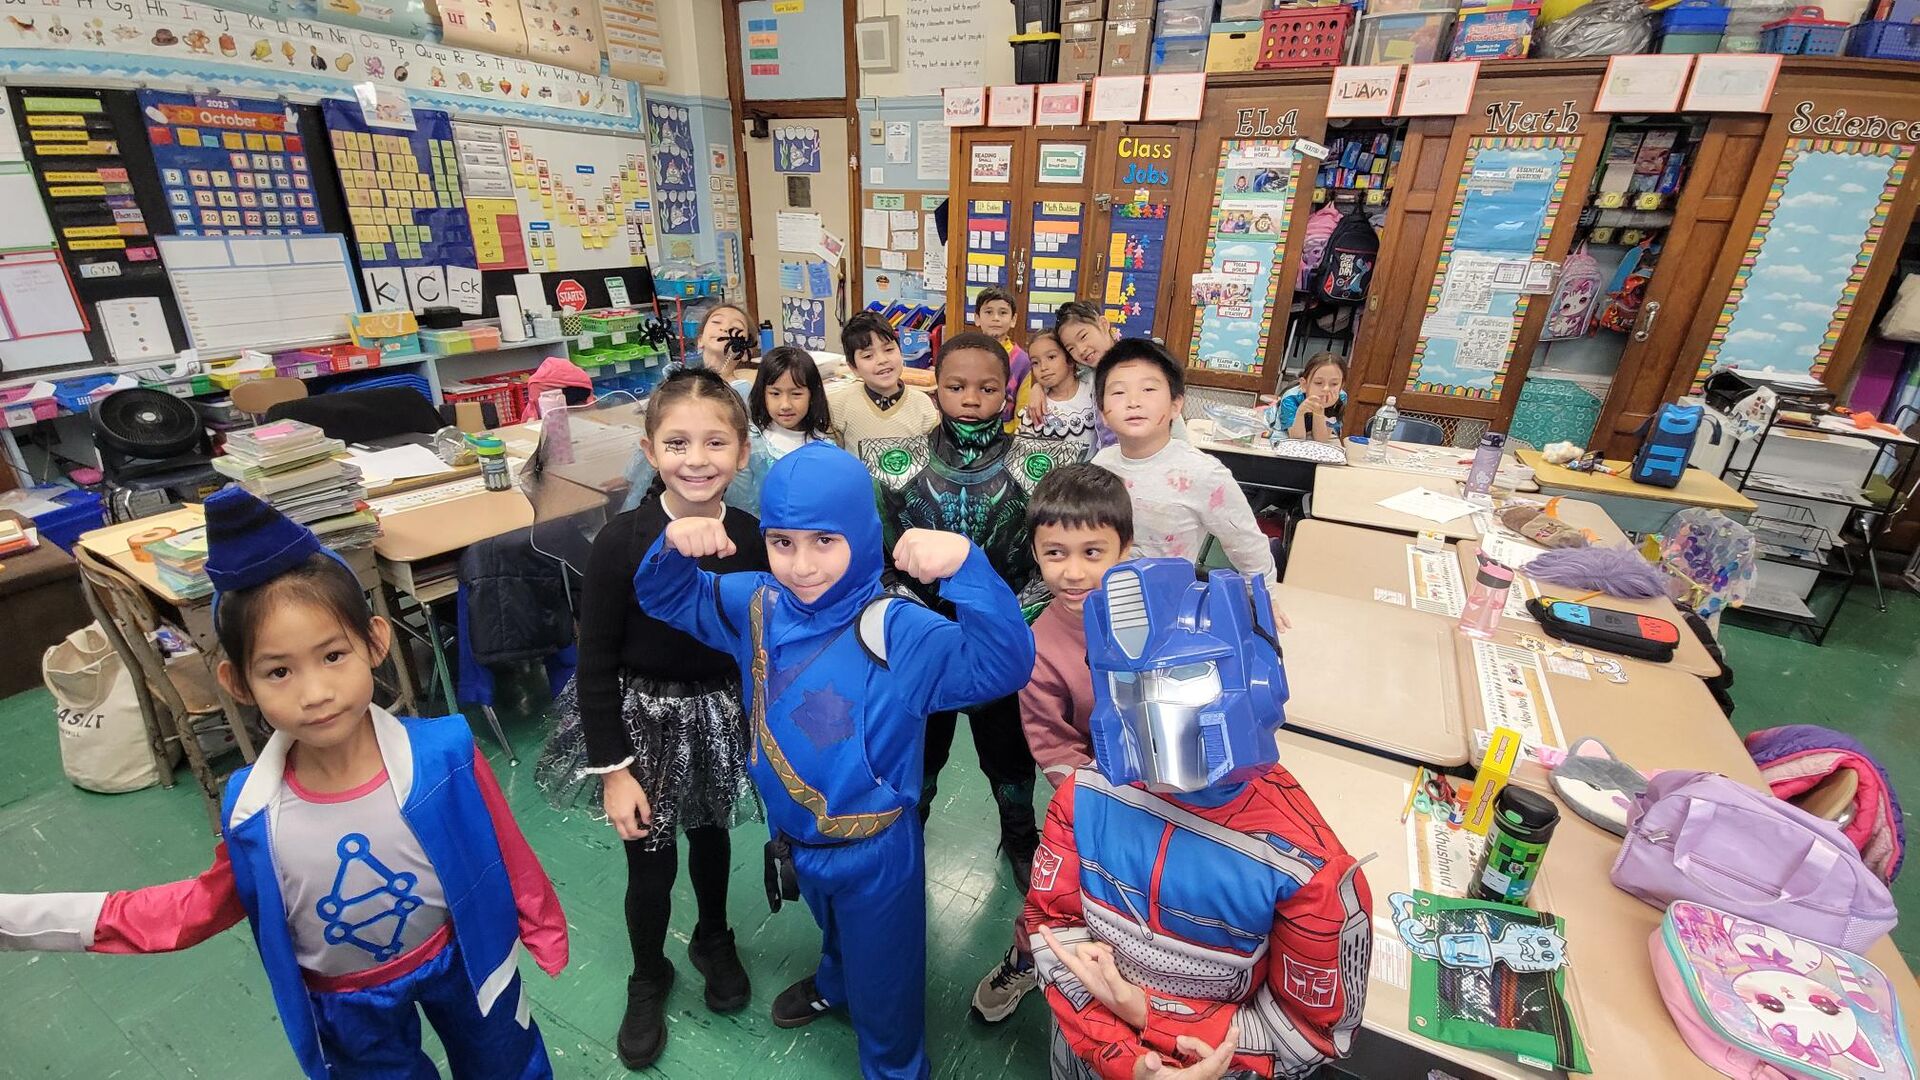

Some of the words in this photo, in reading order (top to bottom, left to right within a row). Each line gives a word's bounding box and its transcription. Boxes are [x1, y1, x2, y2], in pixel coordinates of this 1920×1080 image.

[447, 13, 465, 25] ur
[146, 0, 168, 17] Hh
[213, 8, 229, 31] Jj
[247, 13, 264, 30] Kk
[298, 22, 324, 41] Mm
[329, 28, 347, 44] Nn
[360, 34, 380, 50] Oo
[390, 39, 405, 58] Pp
[1343, 82, 1387, 99] LiAm
[206, 99, 229, 109] 2025
[200, 112, 257, 128] October
[1235, 108, 1299, 137] ELA
[1486, 100, 1580, 135] Math
[1788, 100, 1920, 142] Science
[1118, 137, 1172, 159] Class
[1122, 162, 1169, 185] Jobs
[1045, 203, 1058, 212] Math
[90, 264, 119, 277] GYM
[559, 291, 585, 303] STARTS
[1472, 319, 1509, 328] Addition
